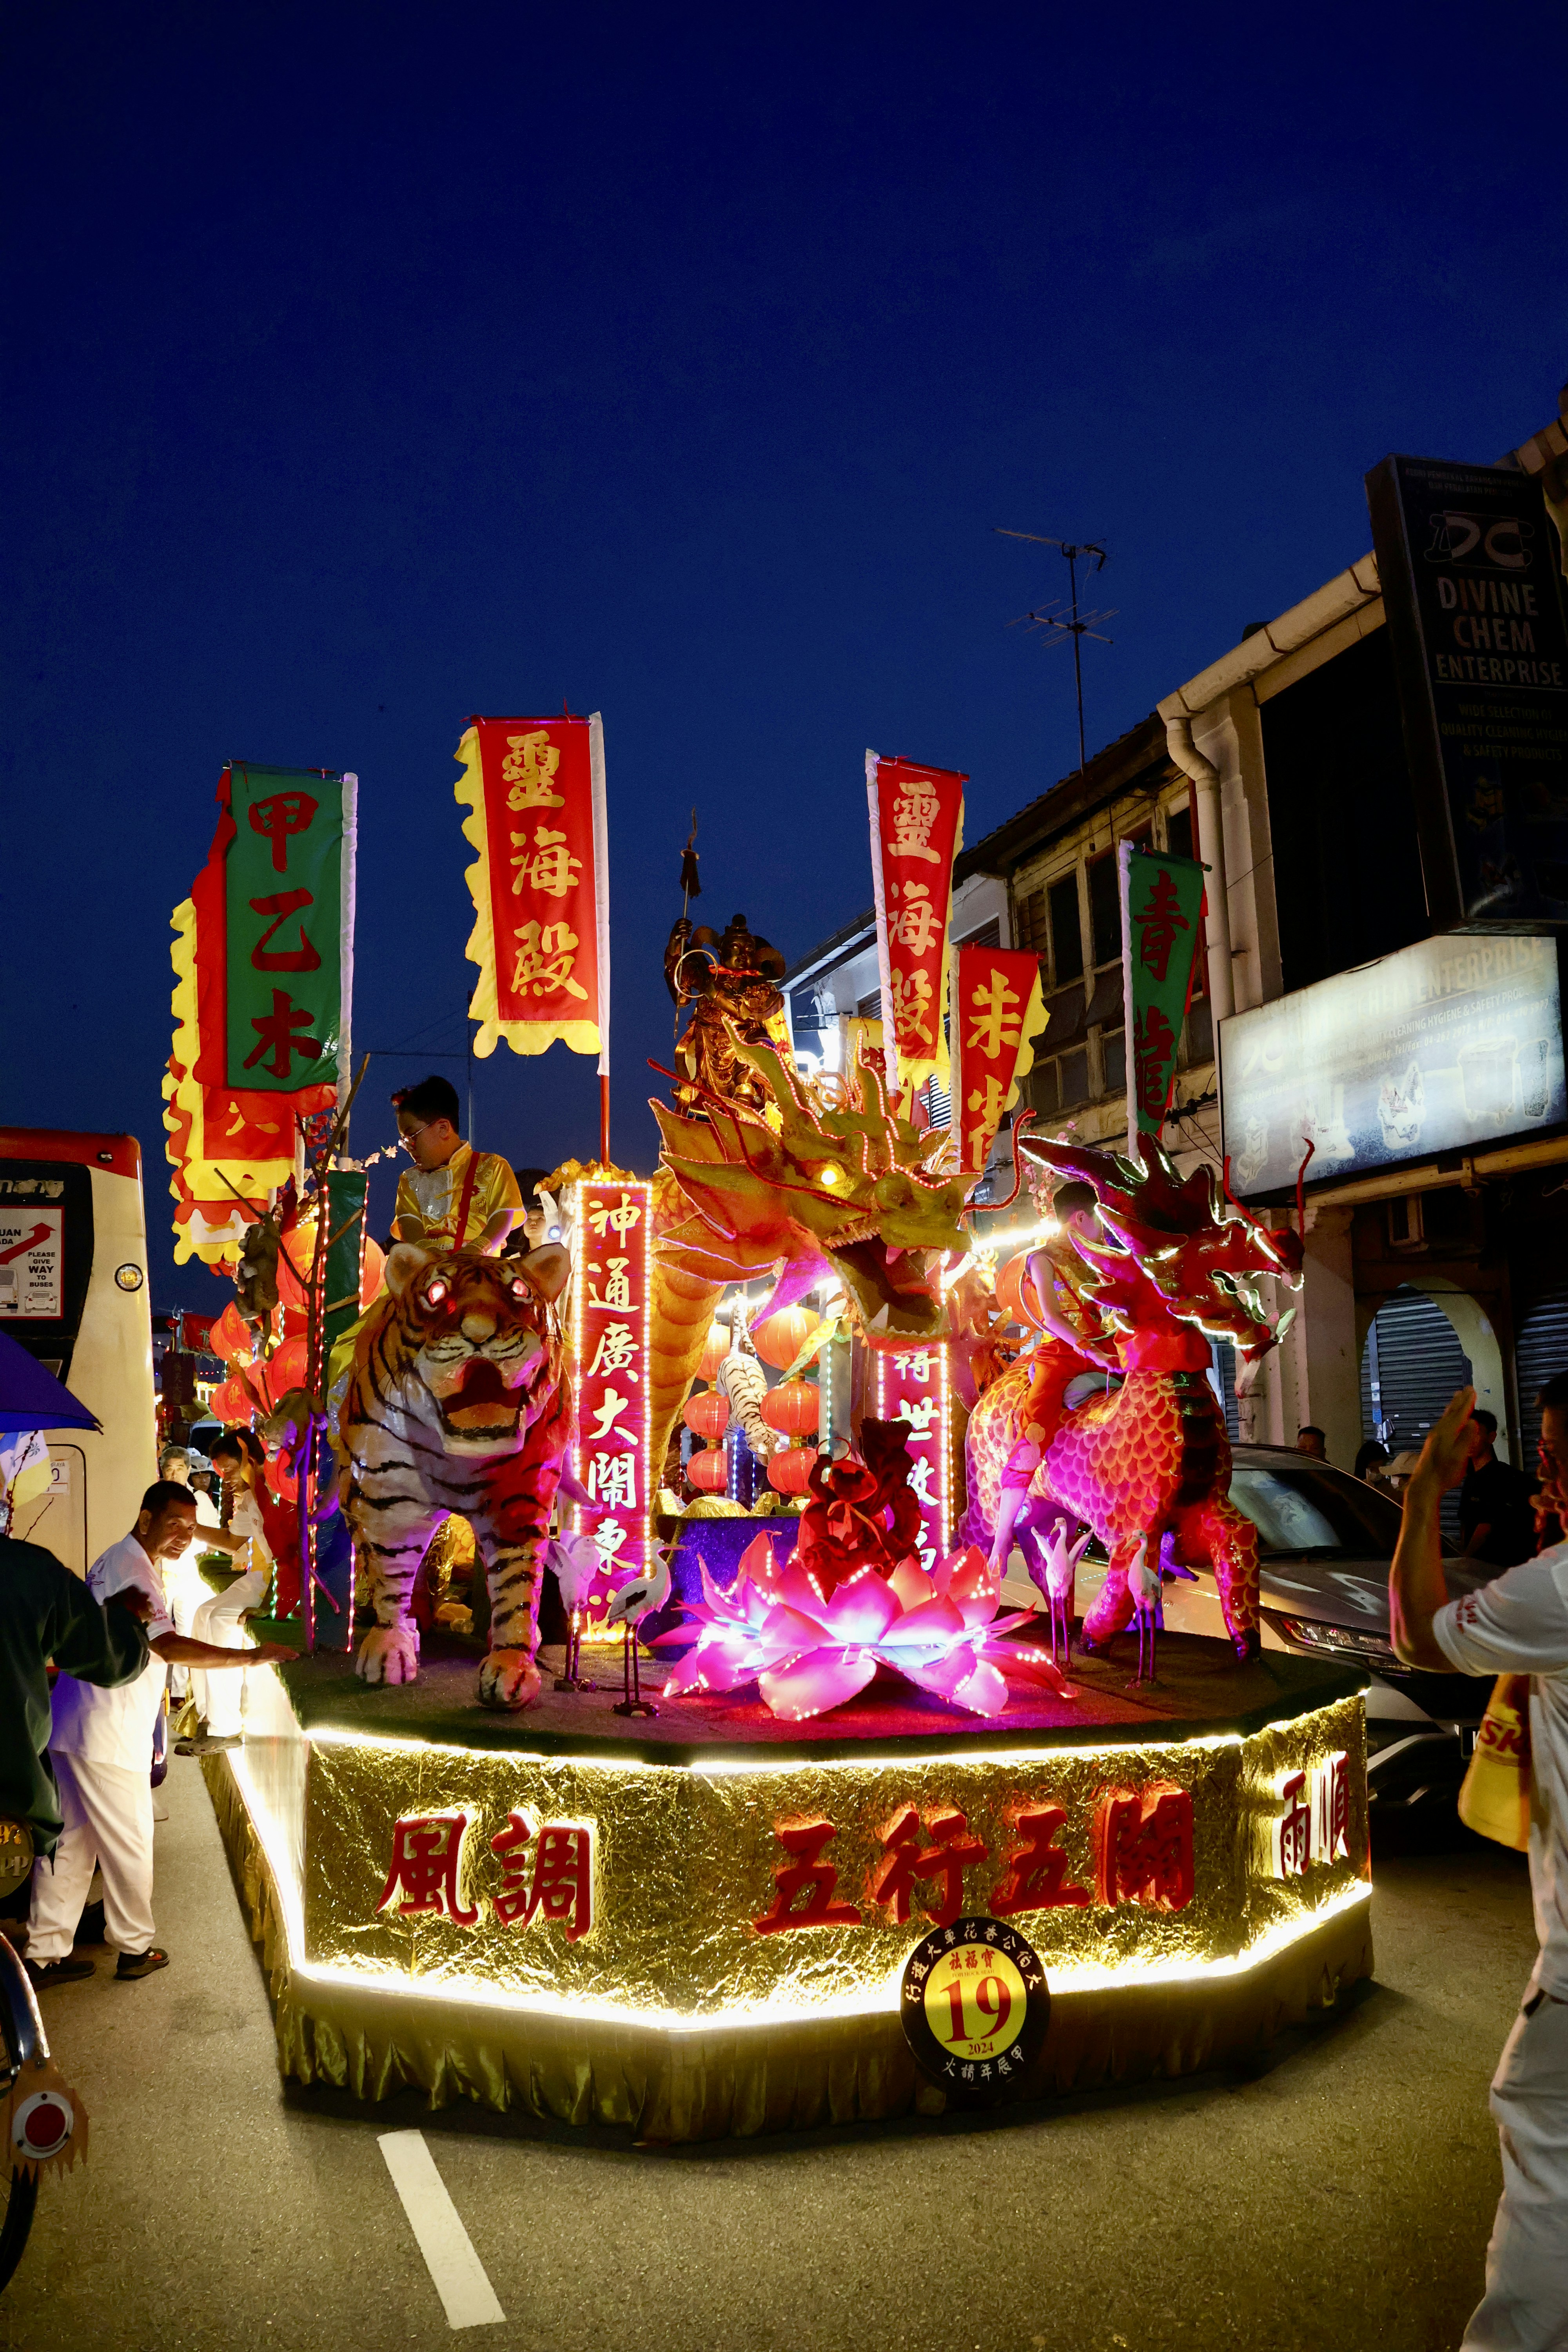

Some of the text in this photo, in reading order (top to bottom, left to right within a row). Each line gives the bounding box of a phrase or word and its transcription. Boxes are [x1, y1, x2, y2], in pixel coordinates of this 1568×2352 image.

[1437, 577, 1539, 616] DIVINE
[1453, 615, 1536, 653] CHEM
[1436, 653, 1564, 686] ENTERPRISE
[1441, 722, 1482, 738] QUALITY
[1486, 724, 1534, 739] CLEANING
[1458, 703, 1486, 717] WIDE
[1487, 705, 1539, 720] SELECTION
[1473, 744, 1508, 758] SAFETY
[1511, 746, 1562, 760] PRODUCTS
[243, 791, 322, 1080] 甲乙木
[1416, 938, 1543, 1003] ENTERPRISE
[1389, 1019, 1425, 1038] CLEANING
[1428, 1007, 1462, 1026] HYGIENE
[1463, 1004, 1469, 1016] &
[1470, 995, 1500, 1013] SAFETY
[1424, 1031, 1449, 1045] 04-262
[1273, 1751, 1350, 1880] 雨順
[376, 1811, 591, 1944] 風調
[940, 1976, 1011, 2043] 19
[968, 2042, 994, 2055] 2024
